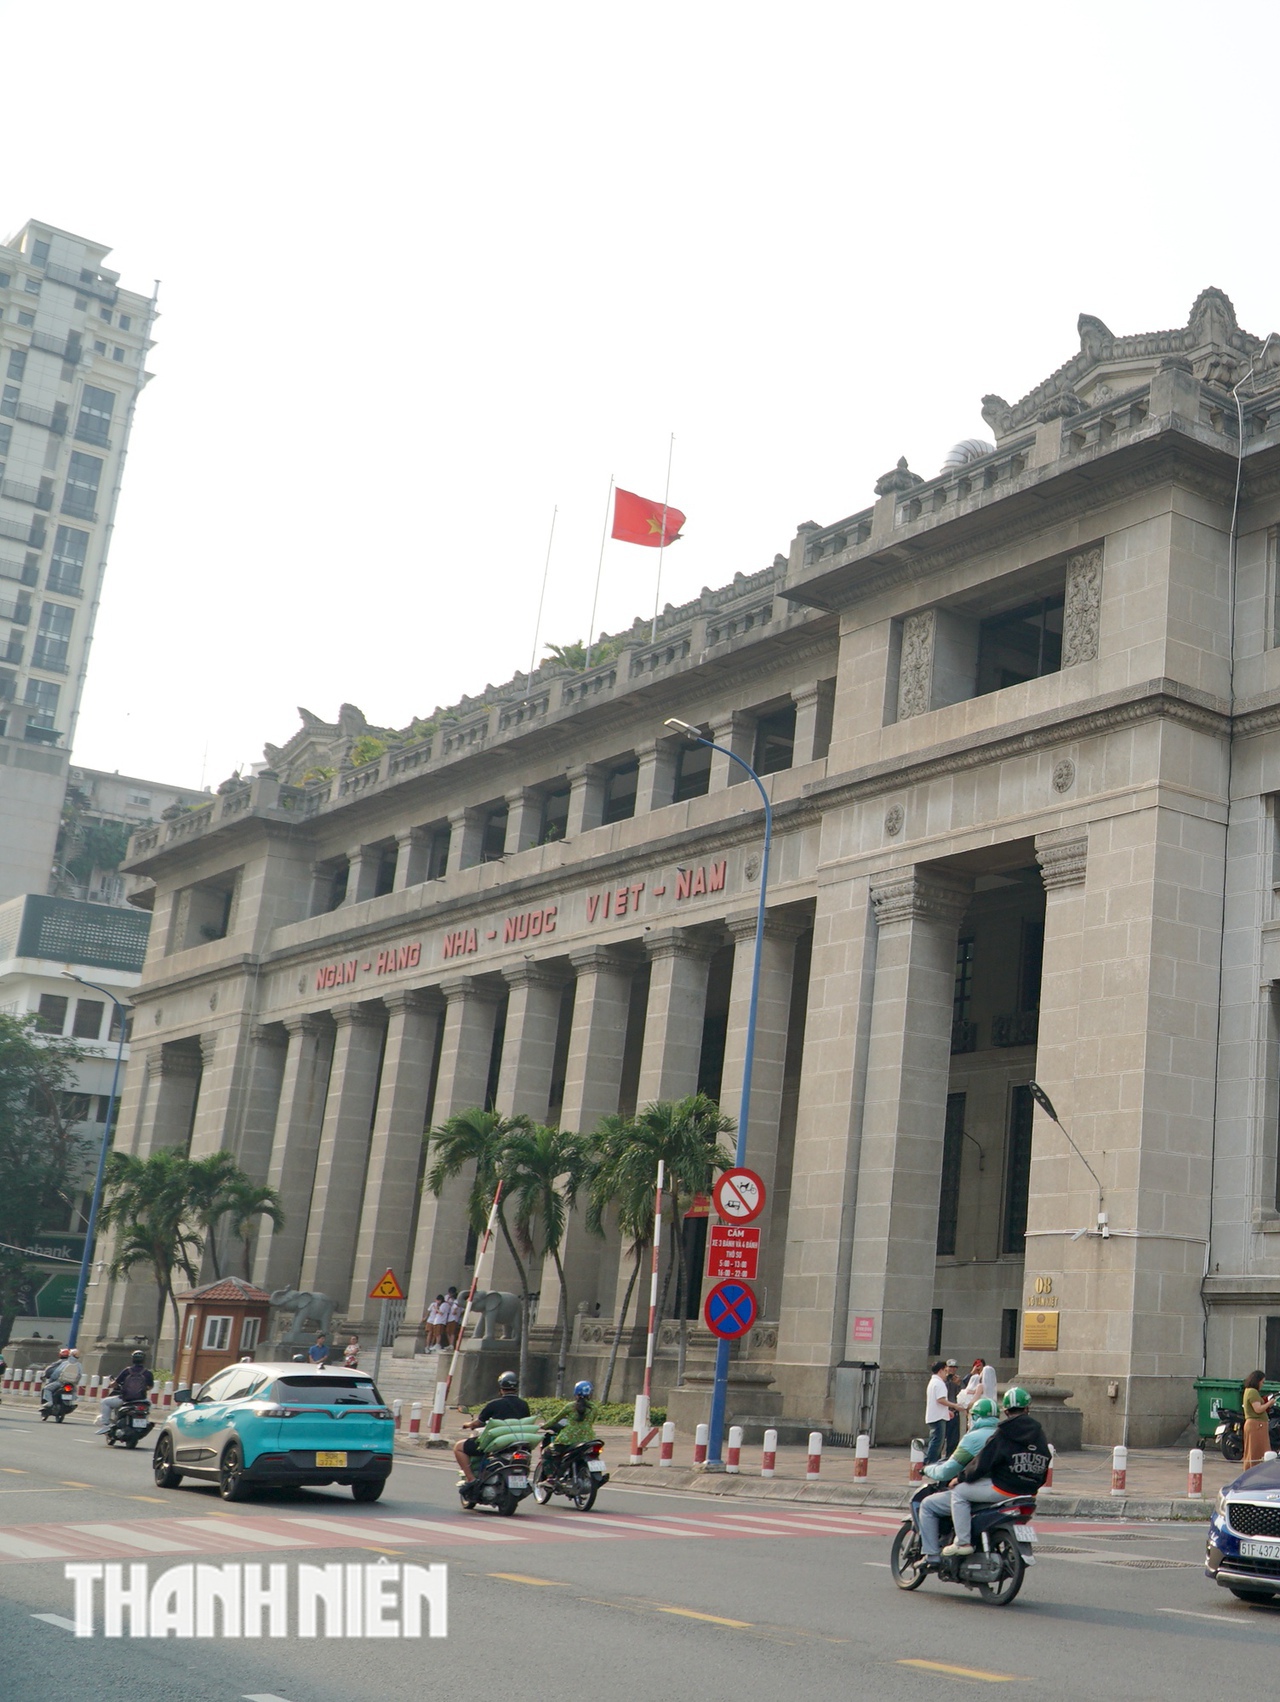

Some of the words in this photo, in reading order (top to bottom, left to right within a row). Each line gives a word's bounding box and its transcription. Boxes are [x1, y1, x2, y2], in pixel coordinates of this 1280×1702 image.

[316, 959, 357, 990] NGAN
[375, 943, 421, 975] HANG
[443, 928, 477, 959] NHA
[586, 882, 645, 923] VIET
[675, 860, 726, 900] NAM
[712, 1239, 718, 1247] XE
[1035, 1277, 1052, 1294] 08
[1012, 1452, 1049, 1467] TRUST
